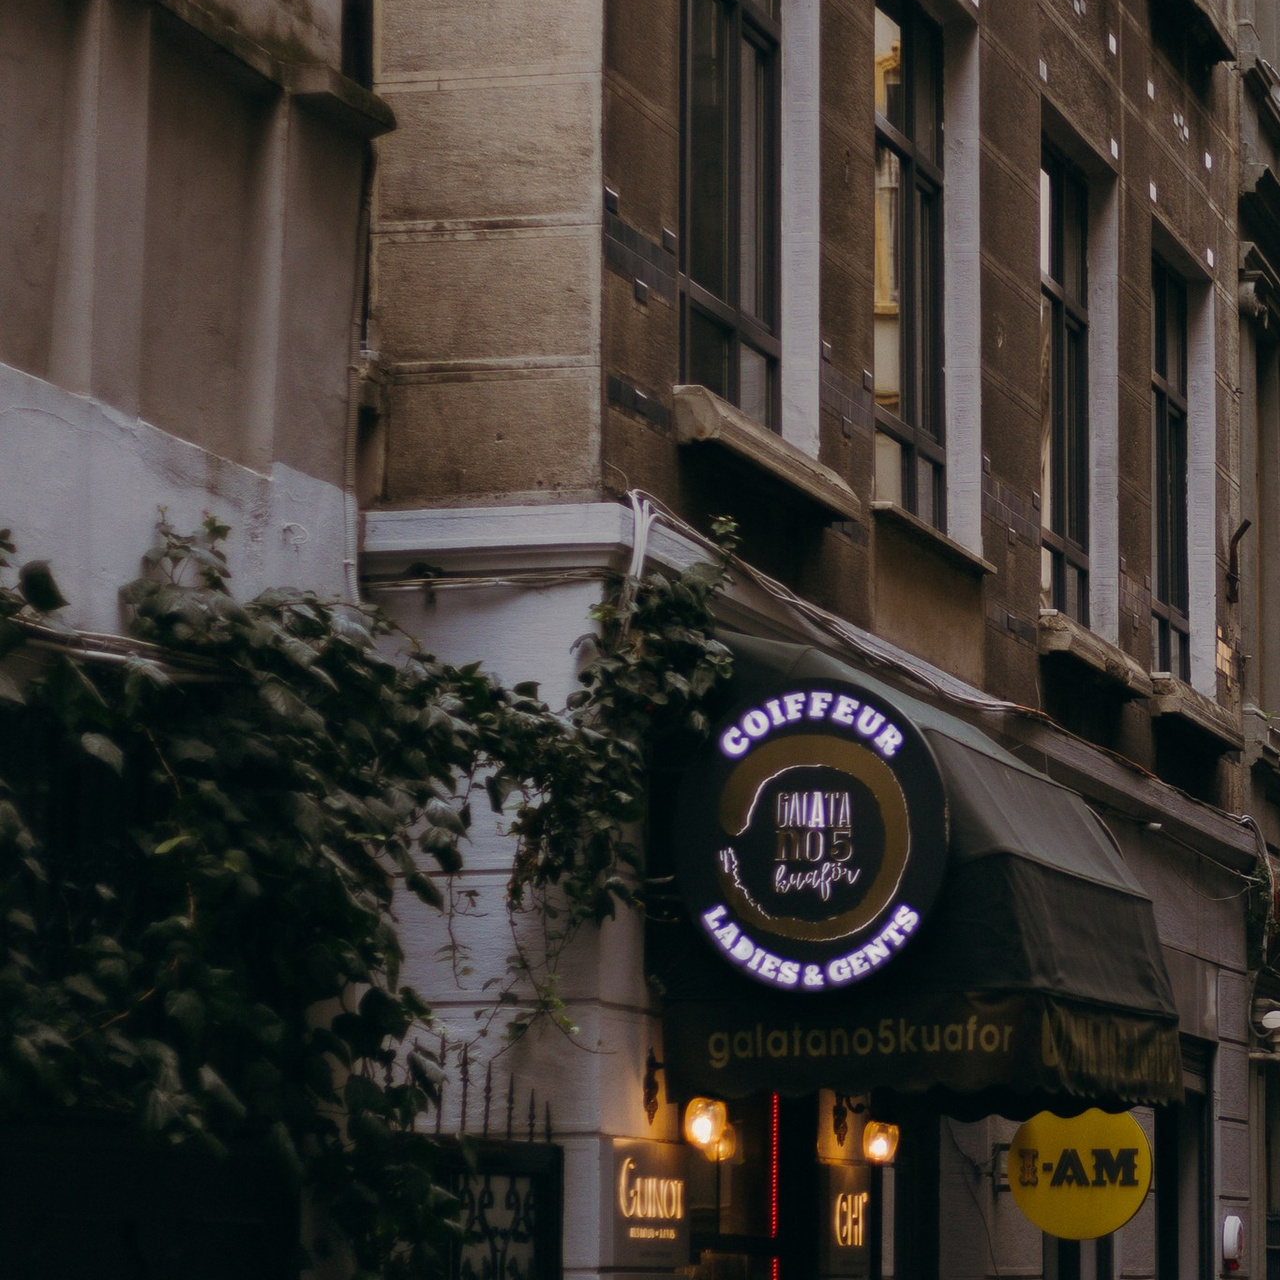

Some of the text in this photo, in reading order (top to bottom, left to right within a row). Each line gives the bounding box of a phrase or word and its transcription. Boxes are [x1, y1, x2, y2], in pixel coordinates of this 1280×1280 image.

[721, 690, 905, 756] COIFFEUR
[776, 791, 852, 828] GALATA
[829, 830, 853, 862] 5
[775, 862, 861, 901] kuaför
[703, 904, 921, 986] LADIES & GENTS
[708, 1015, 1012, 1068] galatano5kuafor
[1017, 1147, 1140, 1187] I-AM
